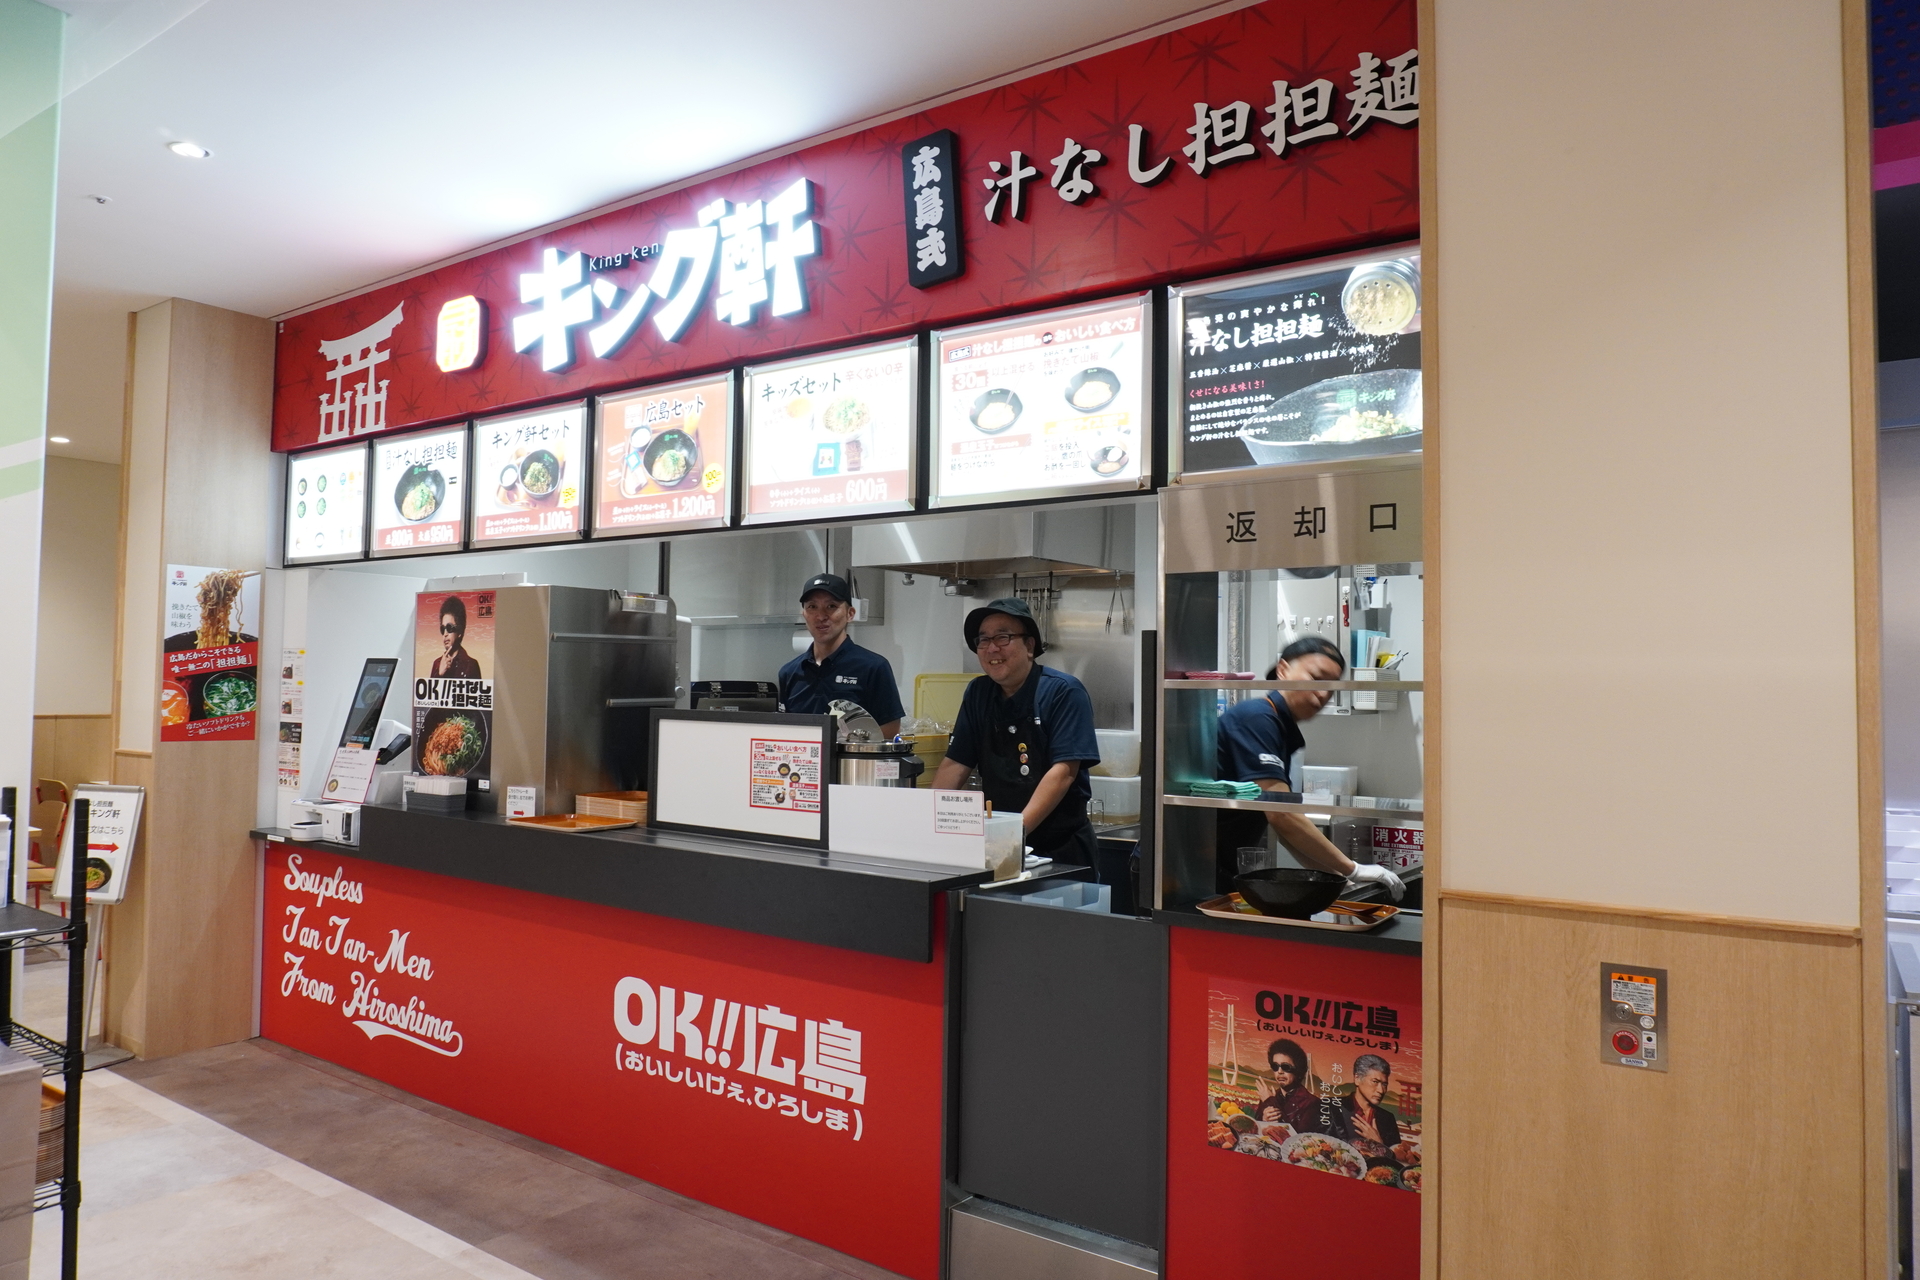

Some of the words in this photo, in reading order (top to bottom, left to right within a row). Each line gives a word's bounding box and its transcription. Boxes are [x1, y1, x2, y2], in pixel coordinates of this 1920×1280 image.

[983, 49, 1419, 222] 汁なし担担麺
[911, 145, 947, 272] 広島式
[588, 241, 660, 272] King-ken
[513, 178, 818, 371] キング軒
[1054, 317, 1136, 343] おいしい食べ方
[761, 372, 841, 402] キッズセット
[645, 395, 704, 424] 広島セット
[492, 419, 570, 449] キング軒セット
[391, 440, 458, 467] 汁なし担担麺
[845, 478, 888, 503] 600円
[1226, 503, 1396, 543] 返却口
[170, 620, 191, 628] 味わう
[169, 646, 241, 663] 広島だからこそできる
[170, 653, 253, 674] 唯一無二の「担担麺」
[452, 680, 492, 694] 汁なし
[452, 694, 492, 708] 担々麺
[89, 808, 121, 819] キング軒
[1375, 827, 1424, 845] 消火器
[284, 853, 363, 907] Soupless
[282, 904, 323, 950] Tan
[325, 915, 434, 982] Tan-Men
[280, 951, 337, 1006] From
[342, 971, 461, 1045] Hiroshima
[1255, 990, 1400, 1039] OK!!広島
[614, 976, 867, 1105] OK!!広島
